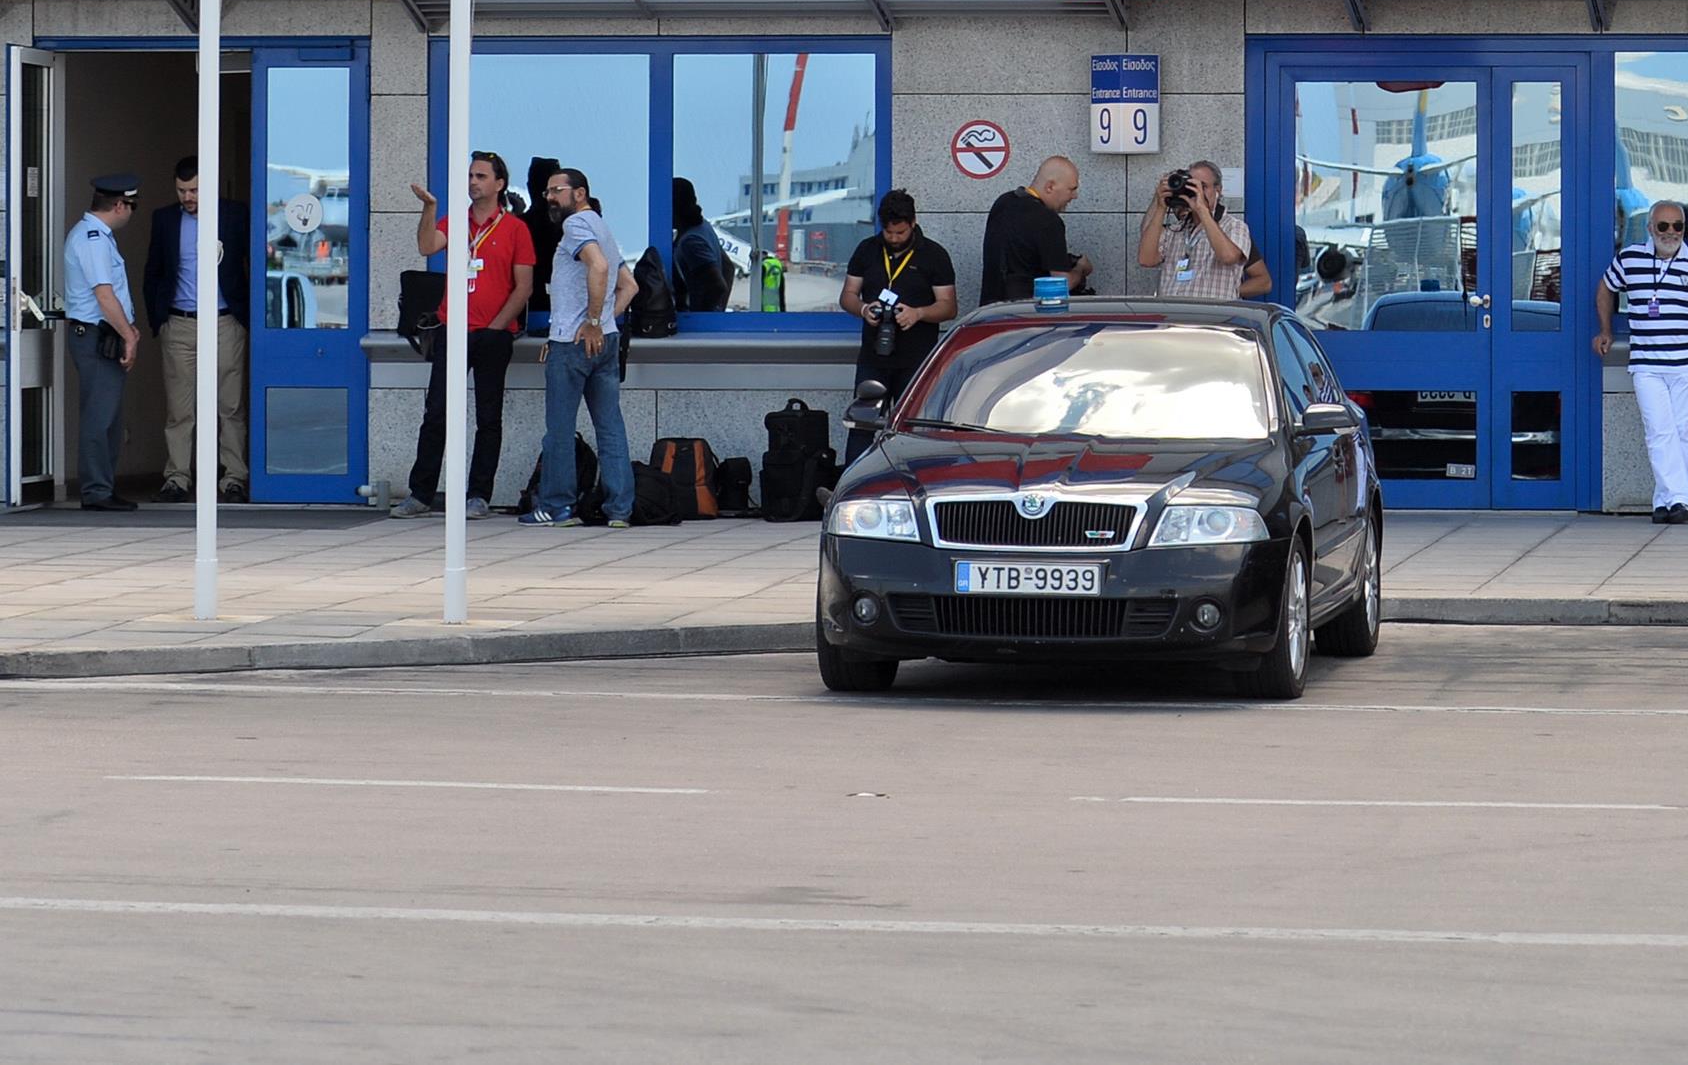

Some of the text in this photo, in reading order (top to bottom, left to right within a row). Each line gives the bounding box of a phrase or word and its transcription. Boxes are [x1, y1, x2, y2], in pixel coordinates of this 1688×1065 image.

[1092, 87, 1120, 99] Entrance
[1122, 86, 1158, 99] Entrance
[1100, 108, 1112, 144] 9
[1133, 108, 1148, 145] 9
